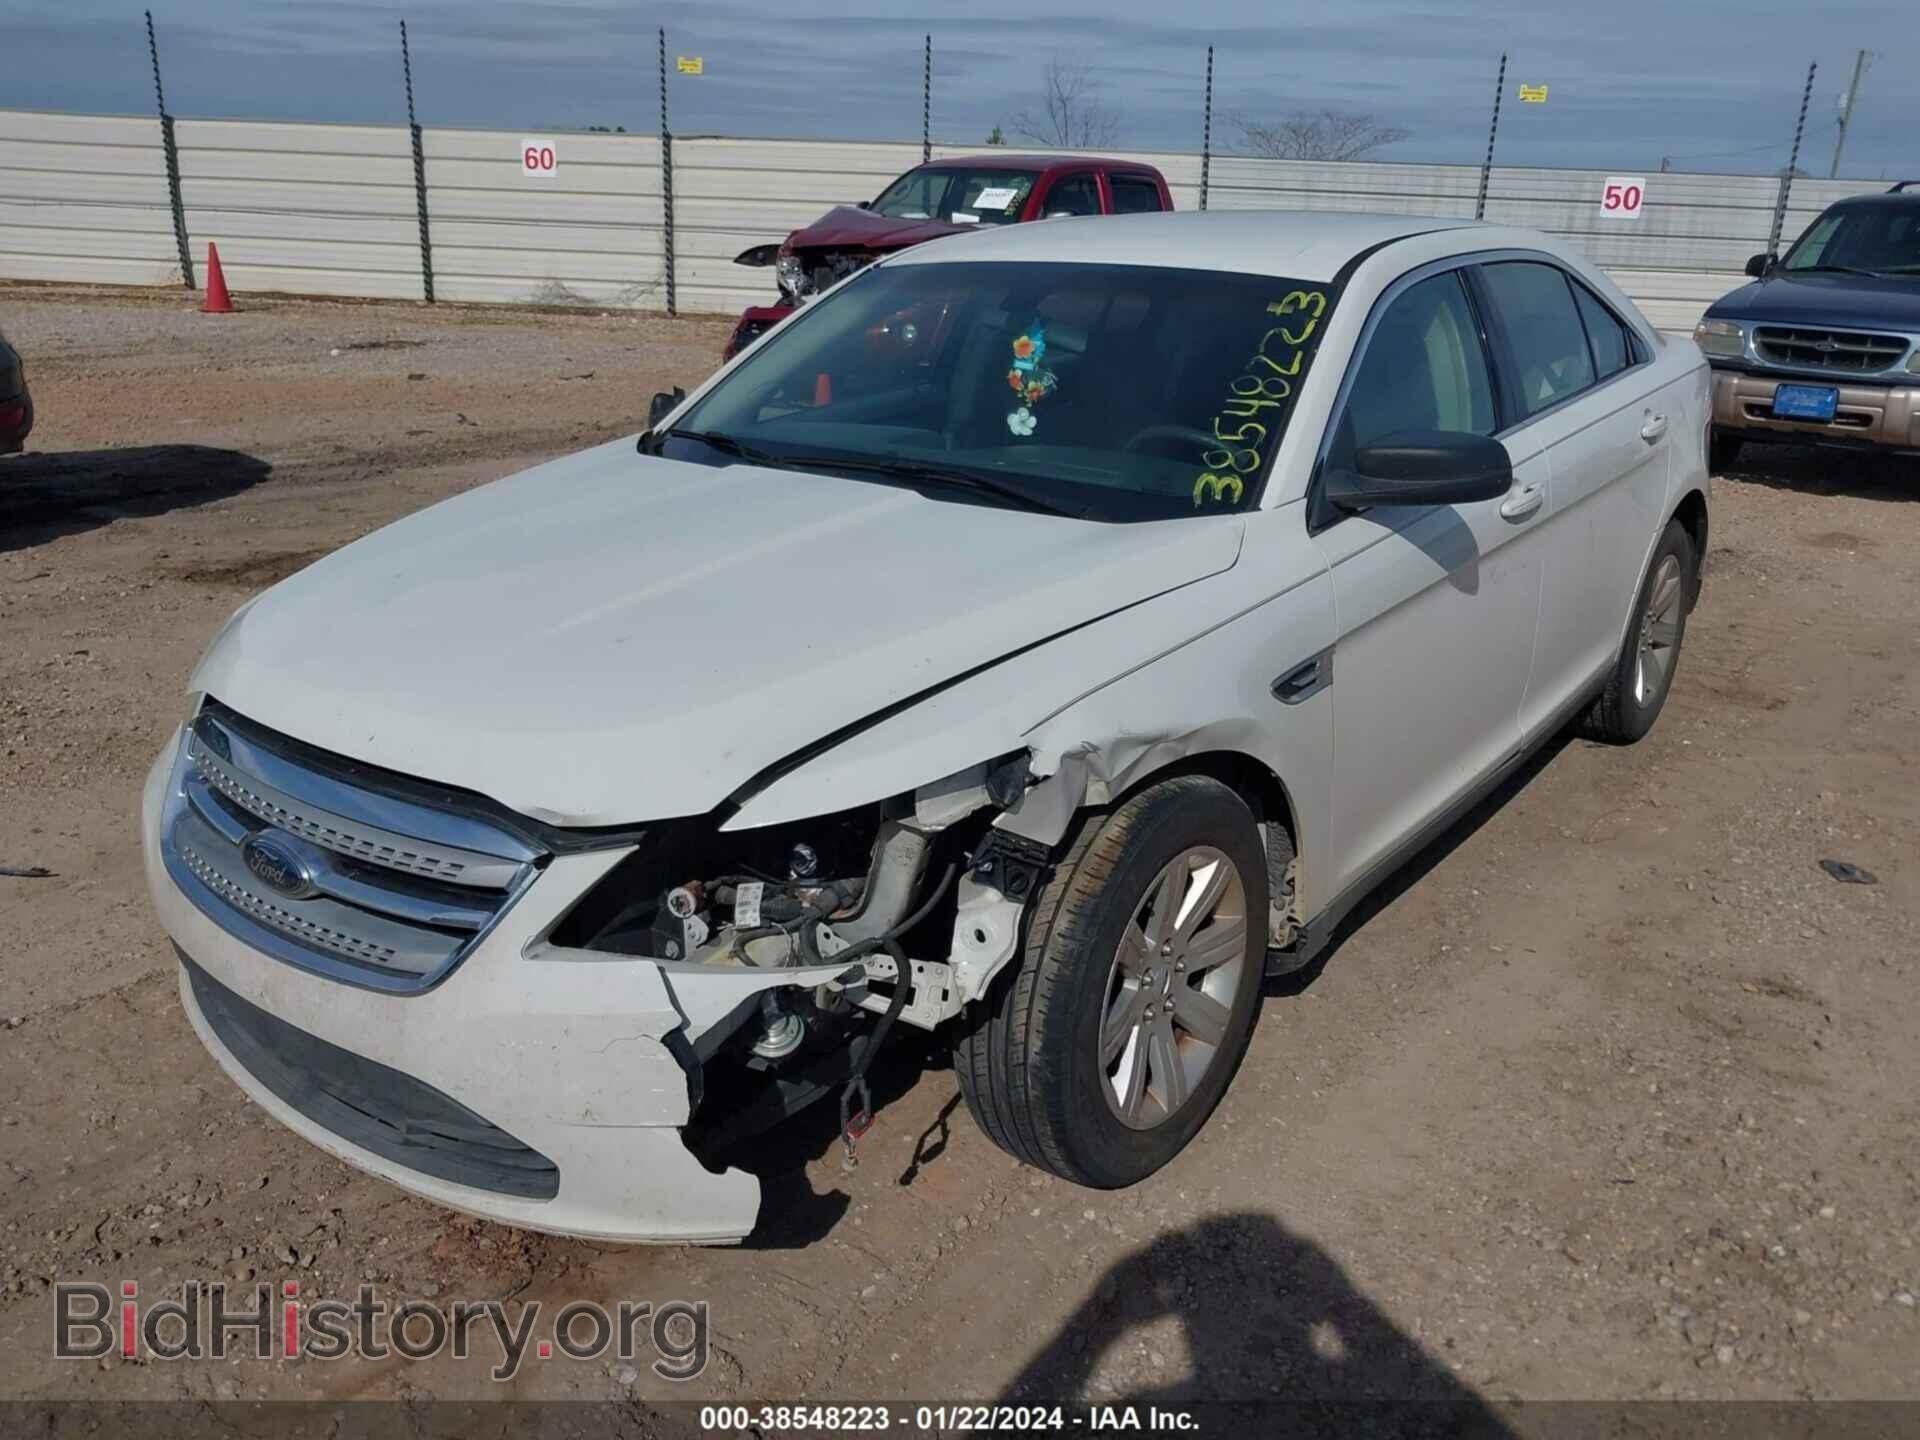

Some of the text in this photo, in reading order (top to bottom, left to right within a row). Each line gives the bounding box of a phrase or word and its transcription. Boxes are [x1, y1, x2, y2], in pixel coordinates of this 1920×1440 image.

[525, 147, 554, 170] 60
[1604, 186, 1641, 210] 50
[1193, 291, 1326, 508] 38548223
